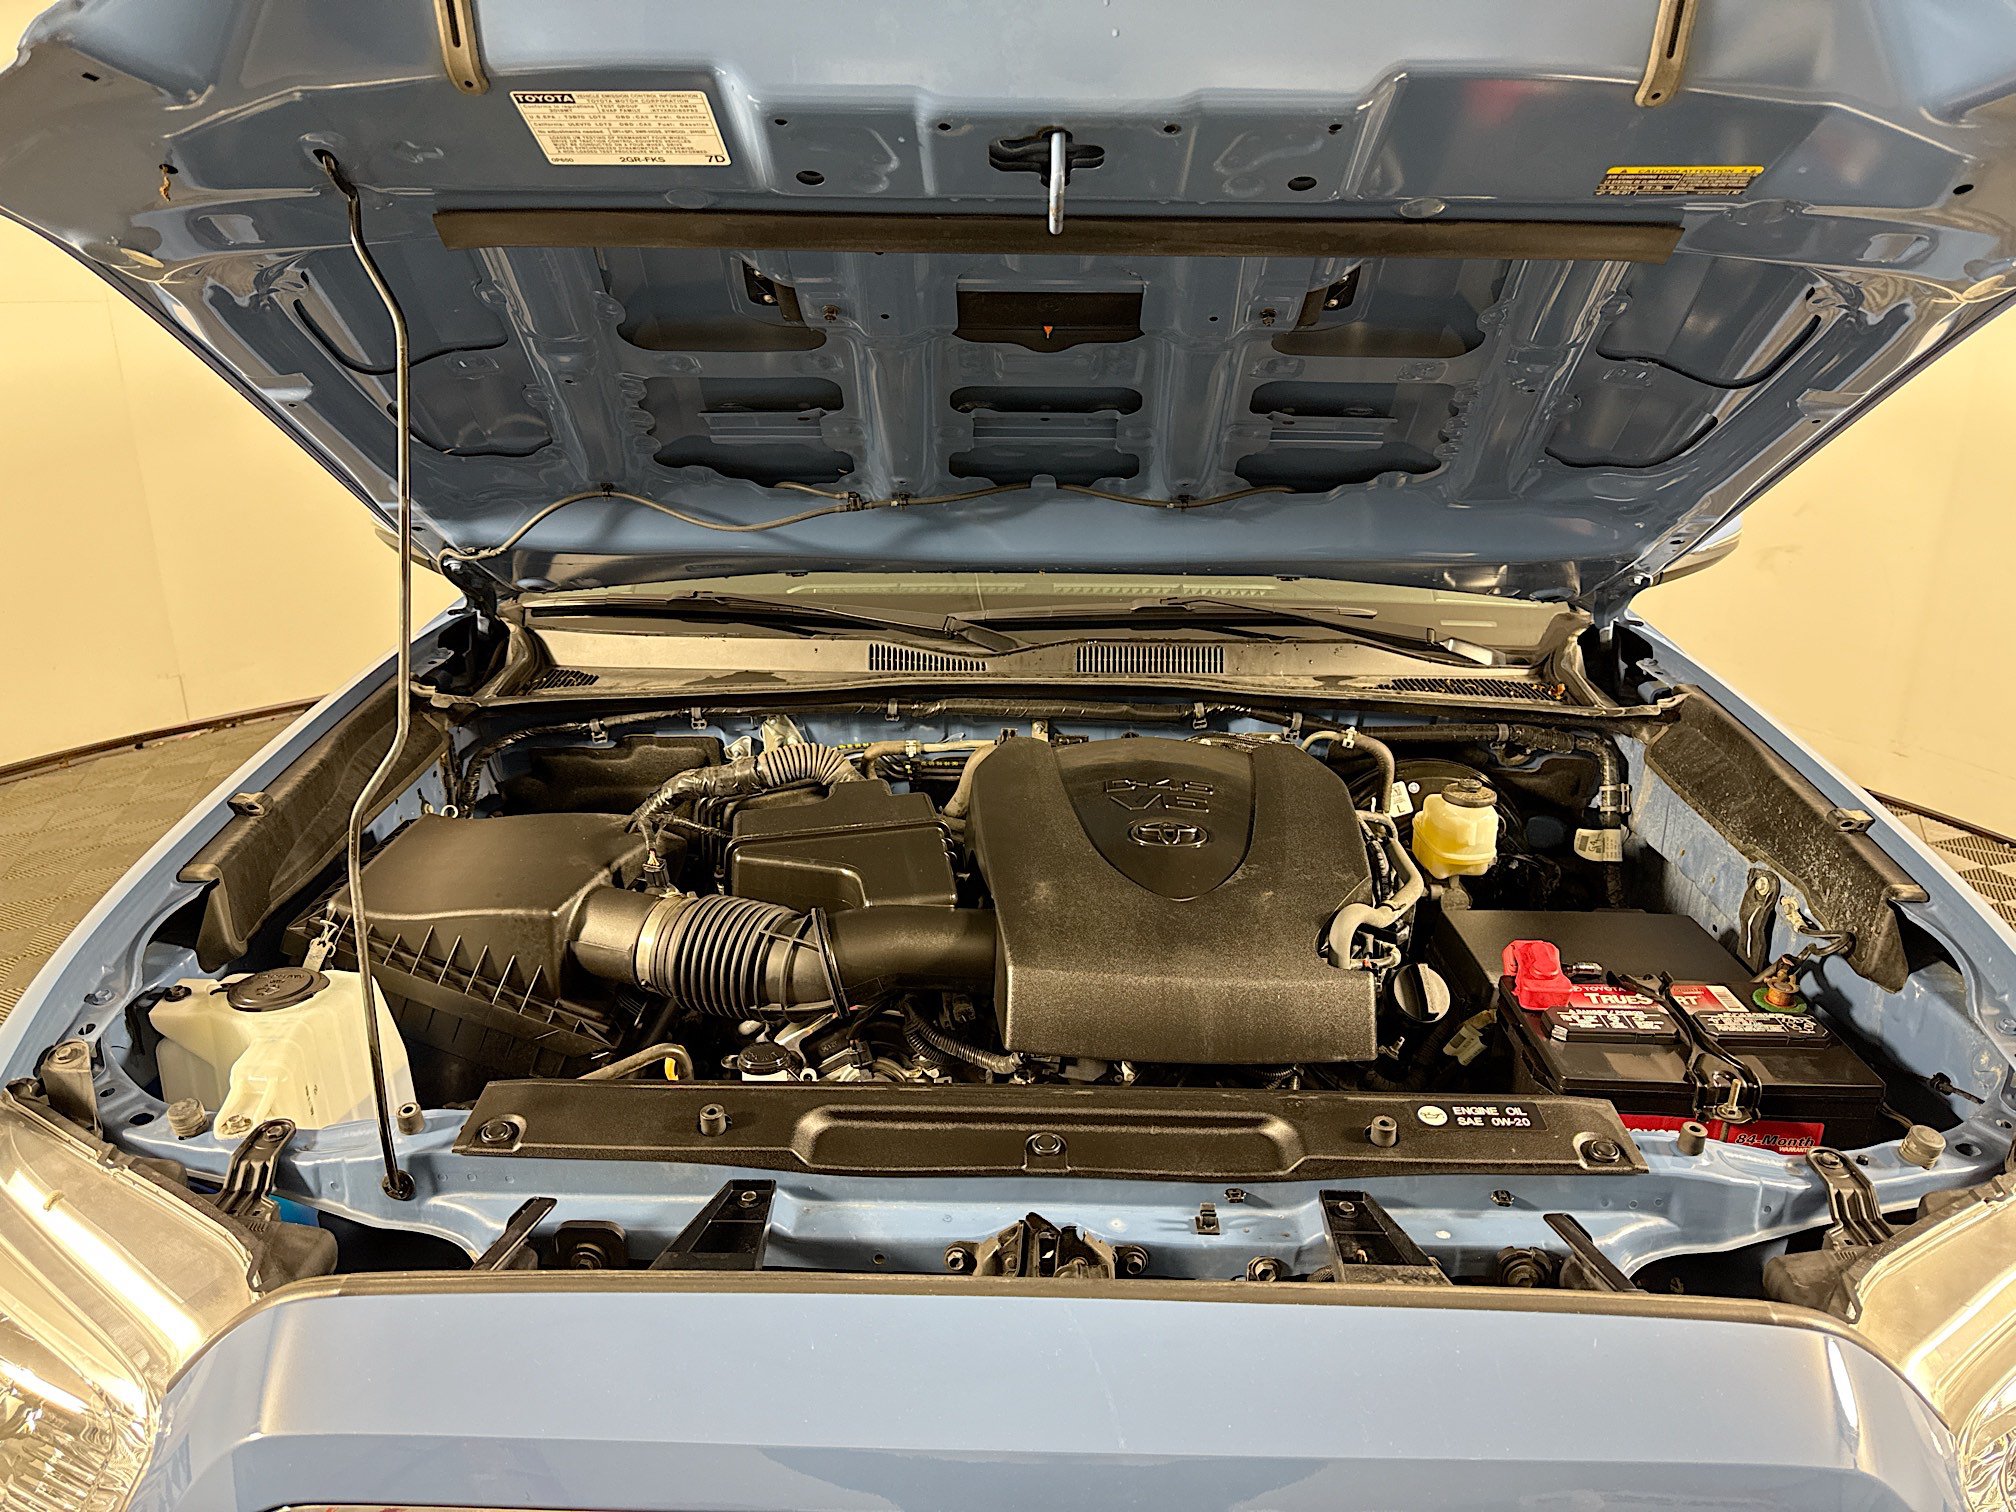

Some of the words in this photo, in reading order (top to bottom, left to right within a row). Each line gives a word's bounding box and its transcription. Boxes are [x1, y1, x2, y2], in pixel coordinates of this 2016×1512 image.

[515, 94, 574, 102] TOYOTA
[705, 155, 726, 163] 7D
[1452, 1106, 1500, 1116] ENGINE
[1505, 1107, 1528, 1116] OIL
[1456, 1116, 1484, 1126] SAE
[1491, 1118, 1531, 1127] 0W-20
[1735, 1134, 1814, 1147] 84-Month
